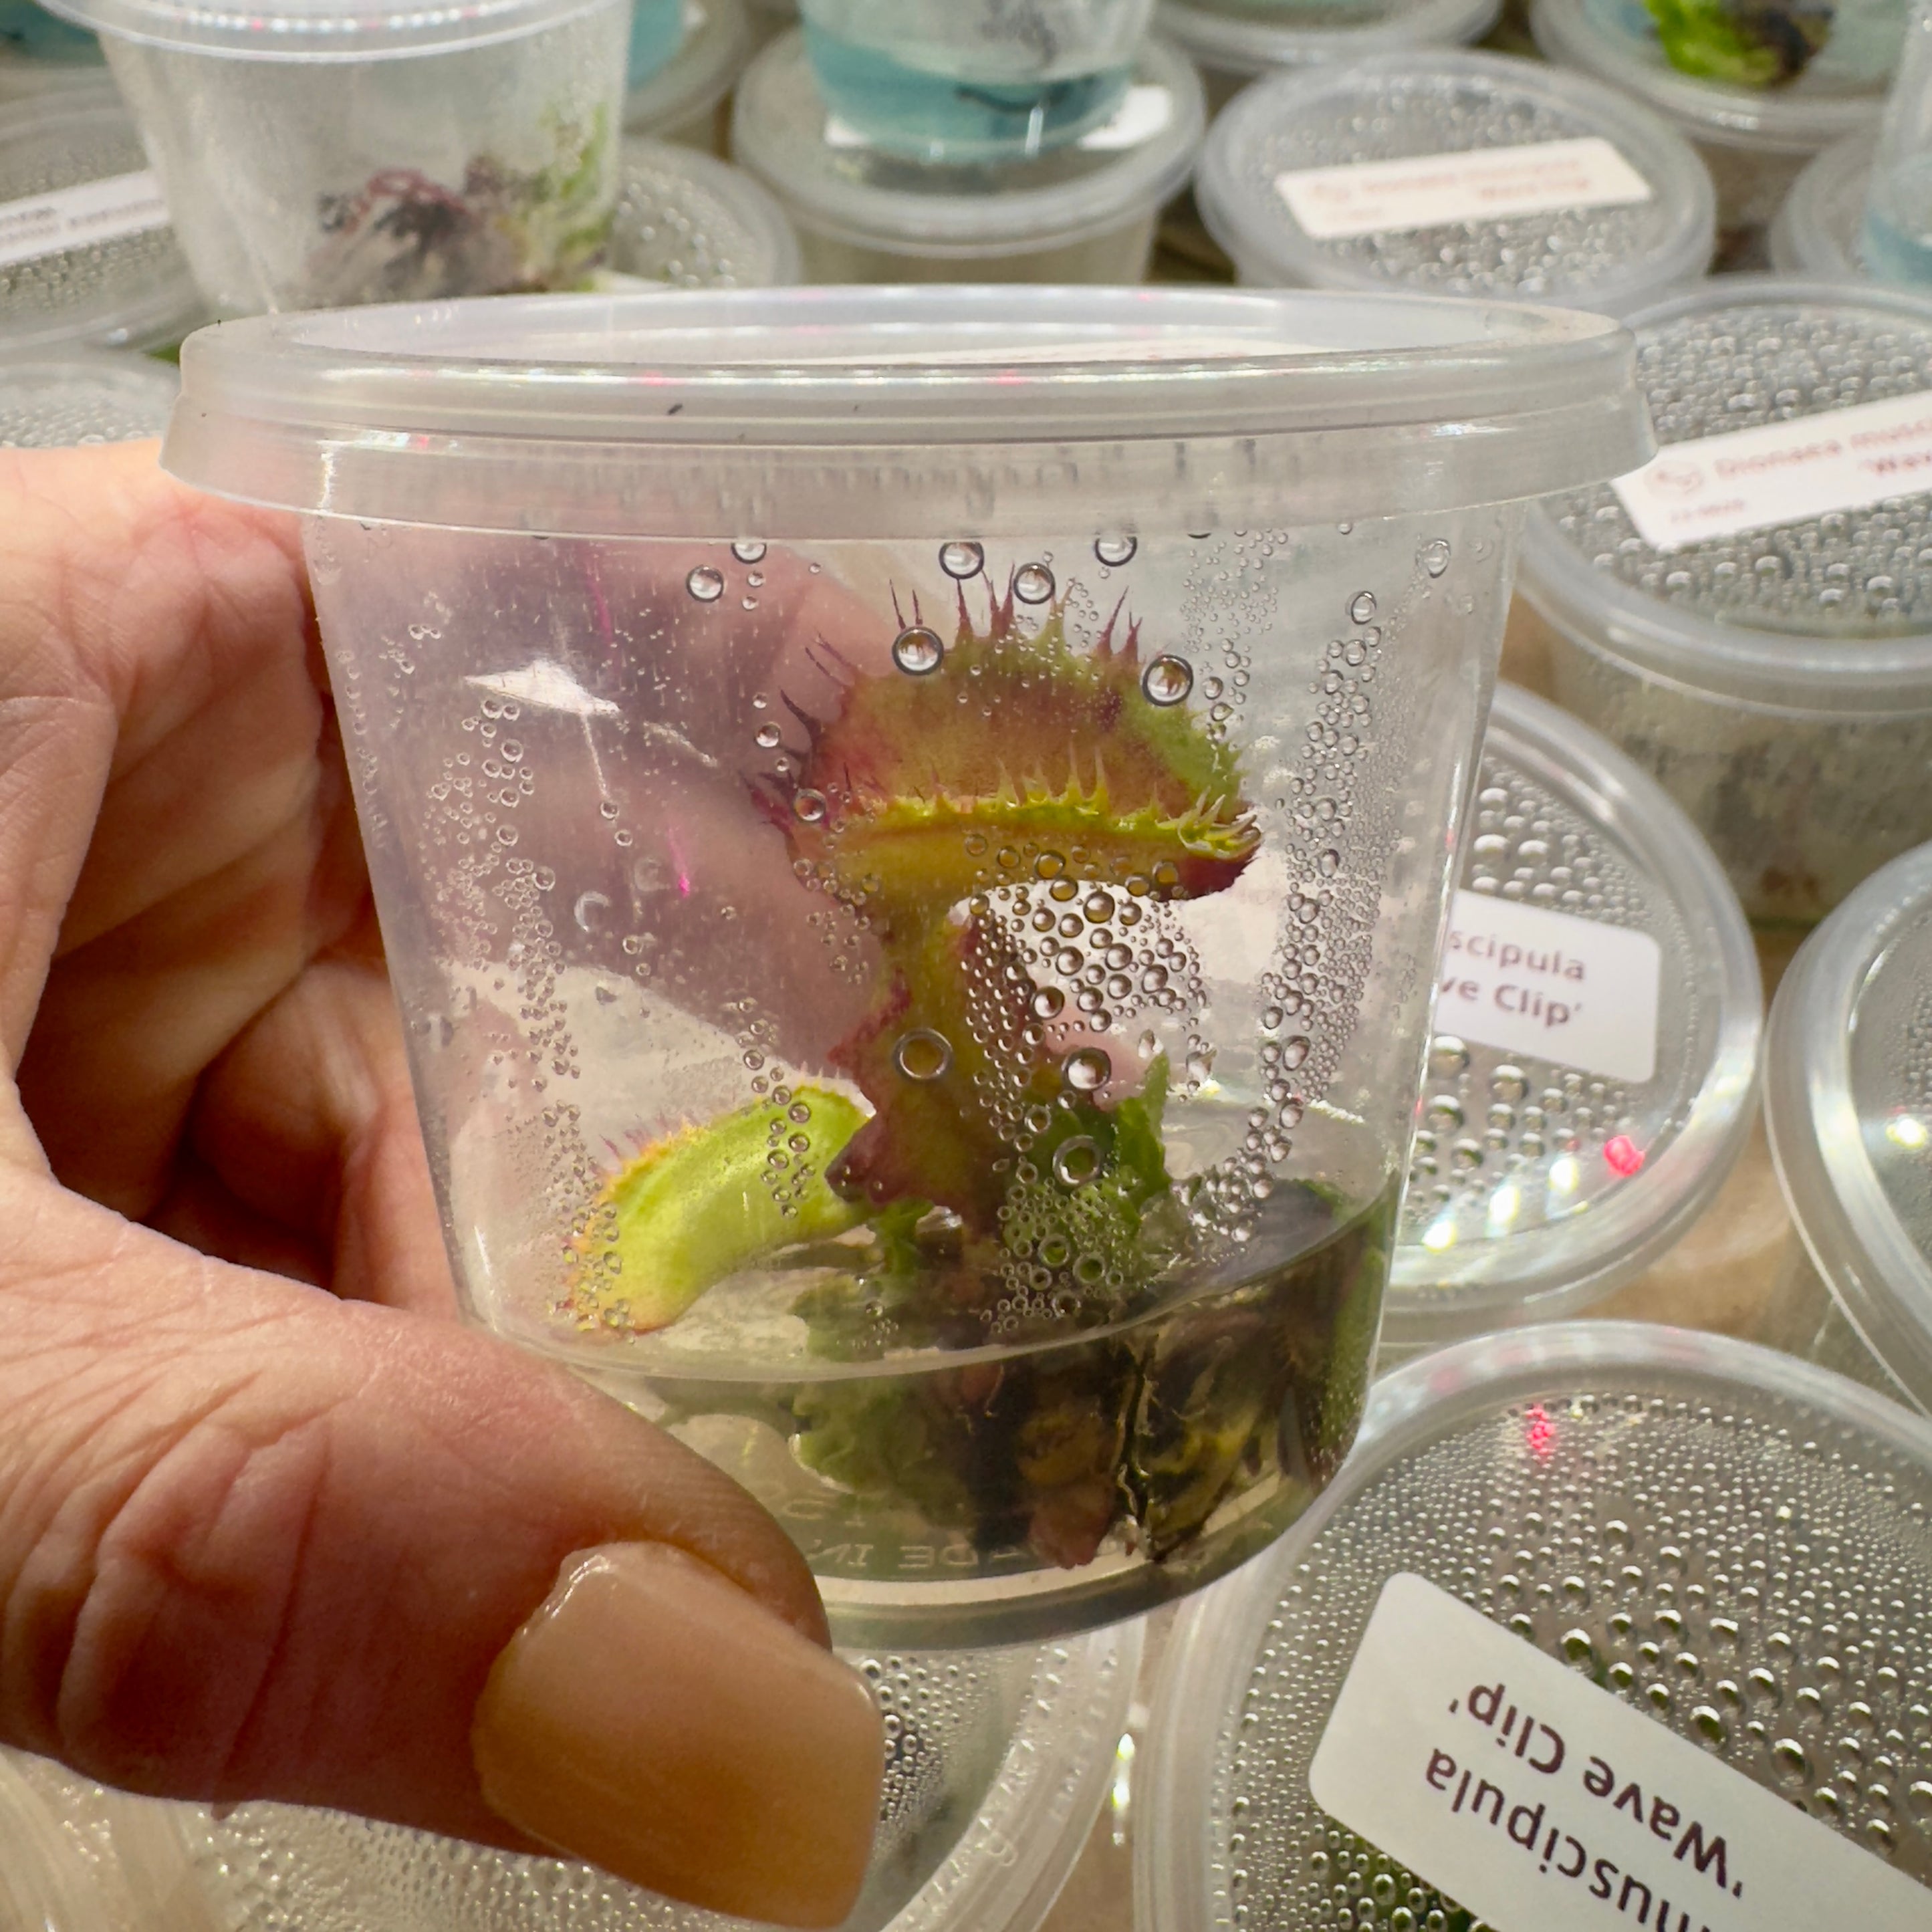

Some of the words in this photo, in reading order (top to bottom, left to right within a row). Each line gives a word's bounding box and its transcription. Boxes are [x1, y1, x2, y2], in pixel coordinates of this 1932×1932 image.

[1449, 929, 1586, 981] scipula
[1494, 983, 1582, 1028] Clip'
[1448, 1683, 1566, 1774] Clip'
[1583, 1756, 1743, 1899] 'Wave
